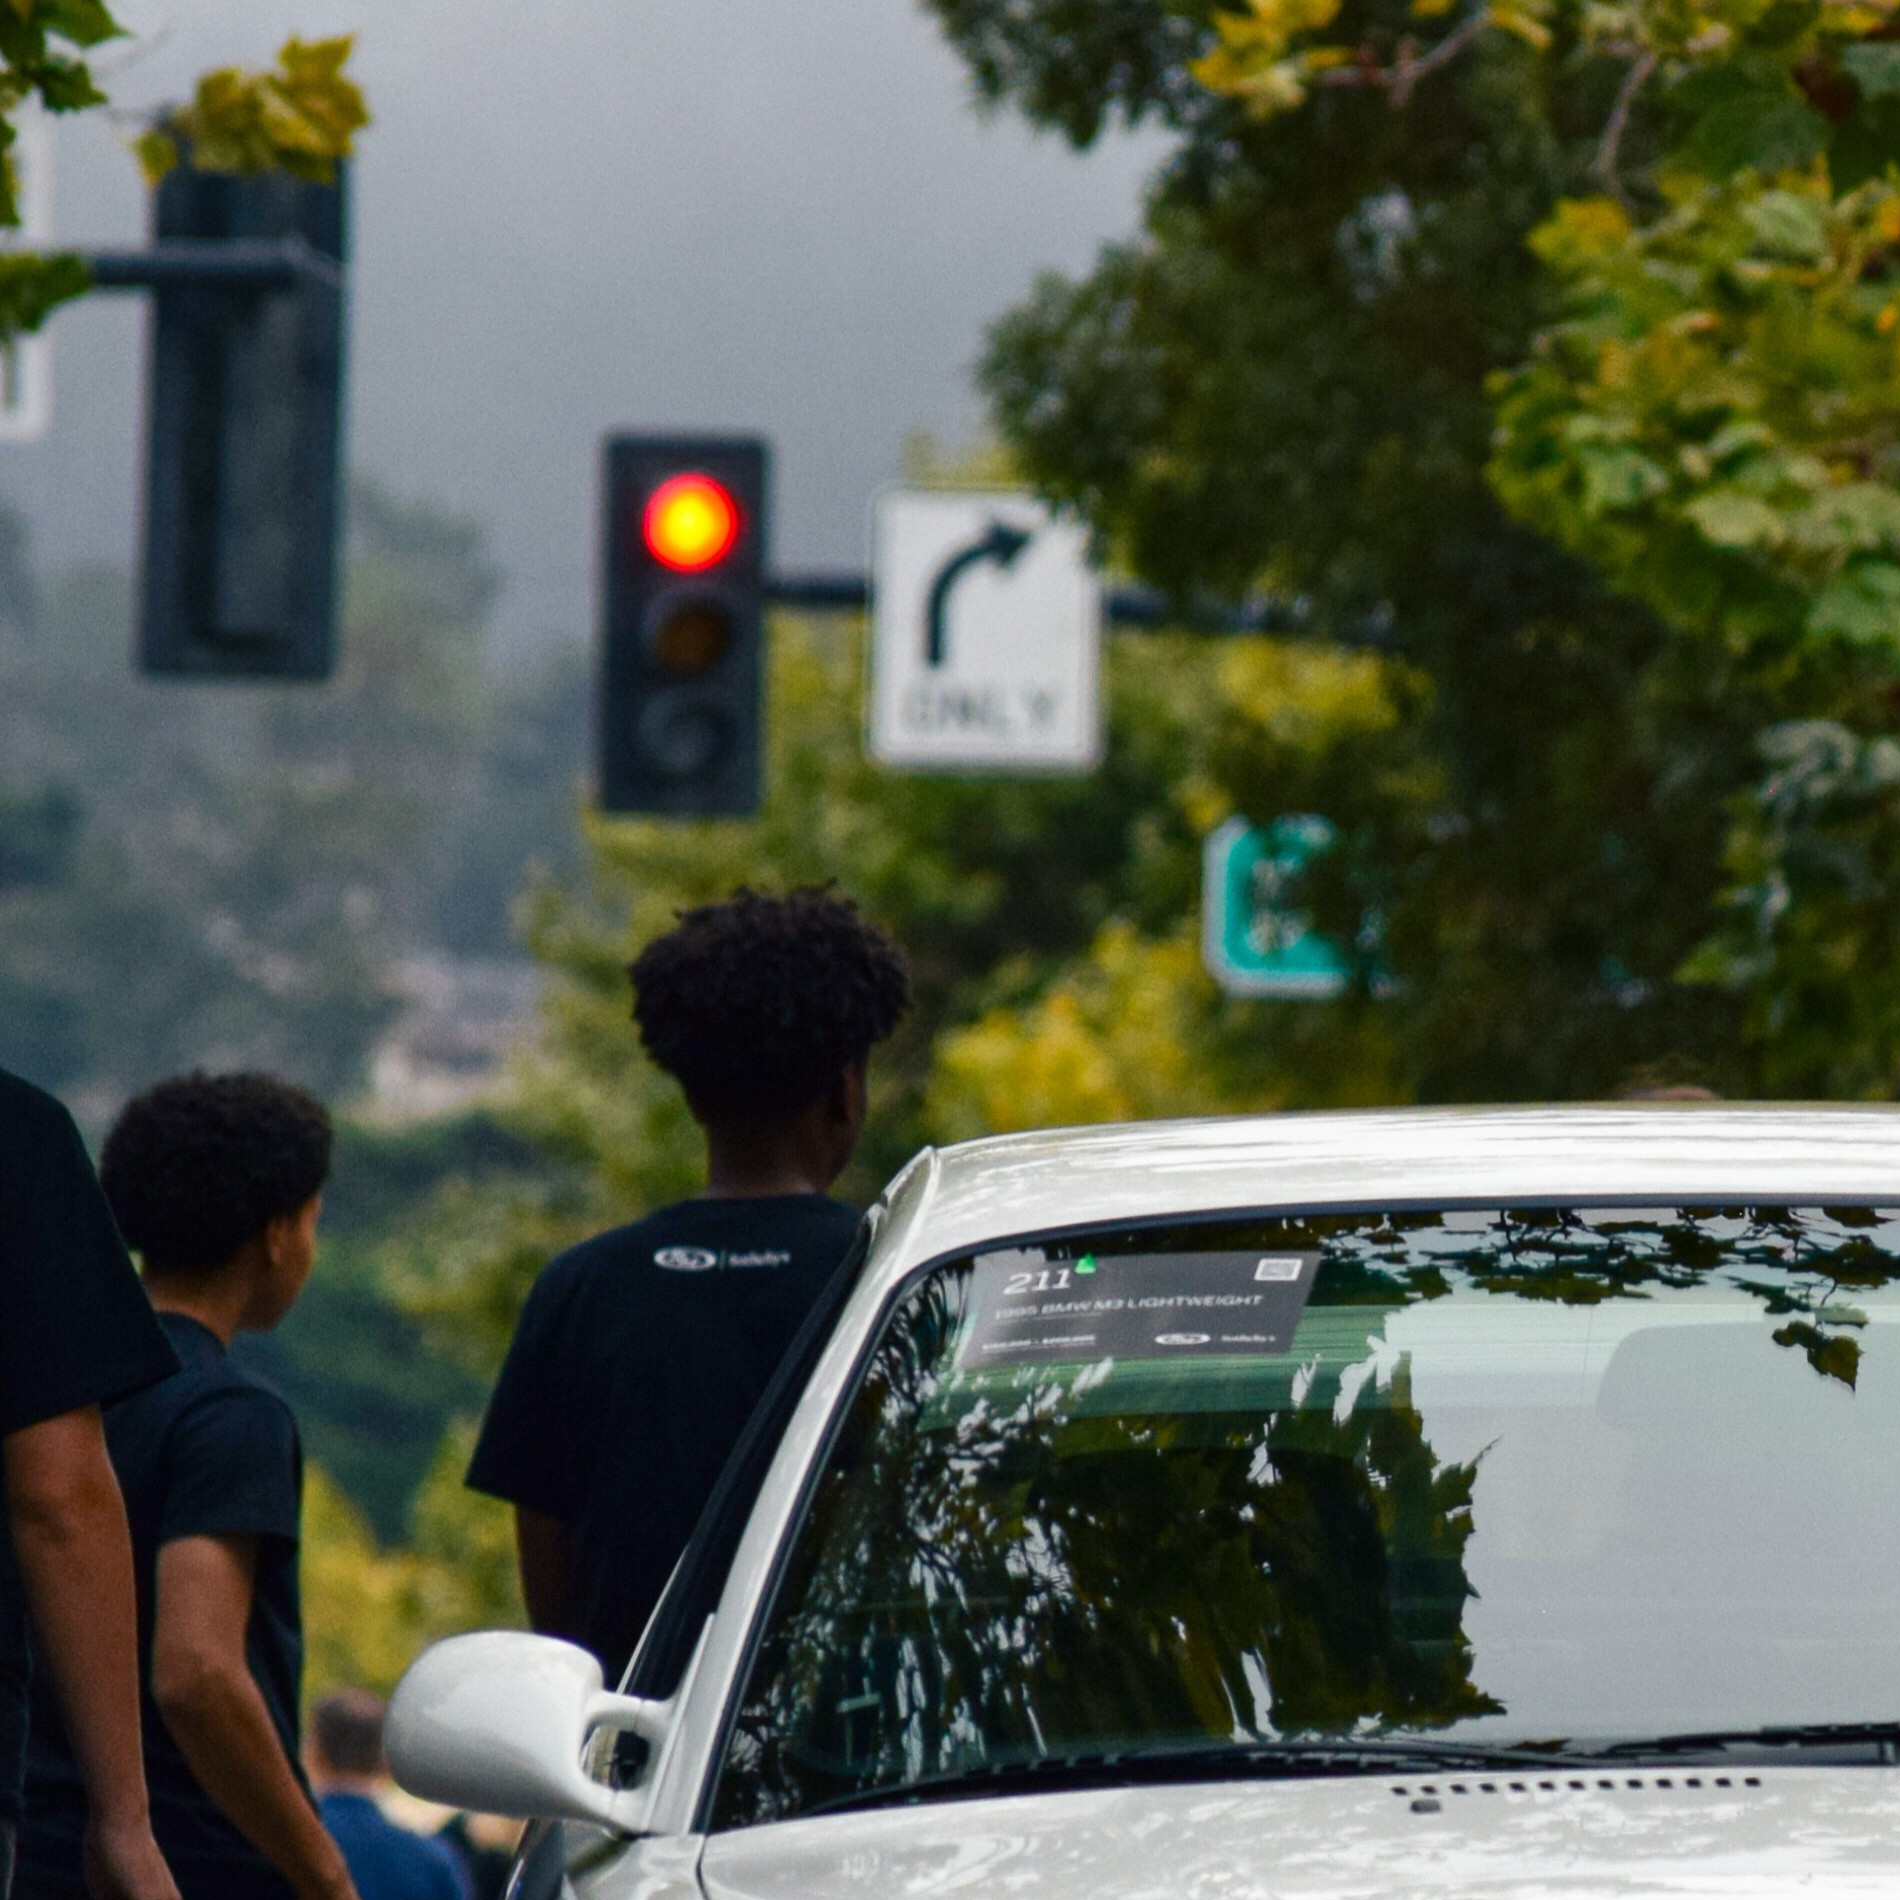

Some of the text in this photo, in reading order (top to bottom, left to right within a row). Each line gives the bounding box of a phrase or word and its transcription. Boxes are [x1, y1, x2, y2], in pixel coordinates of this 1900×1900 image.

[903, 680, 1062, 733] ONLY
[1003, 1267, 1071, 1295] 211
[1041, 1302, 1093, 1315] BMW
[1094, 1299, 1123, 1311] M3
[1127, 1295, 1263, 1309] LIGHTWEIGHT
